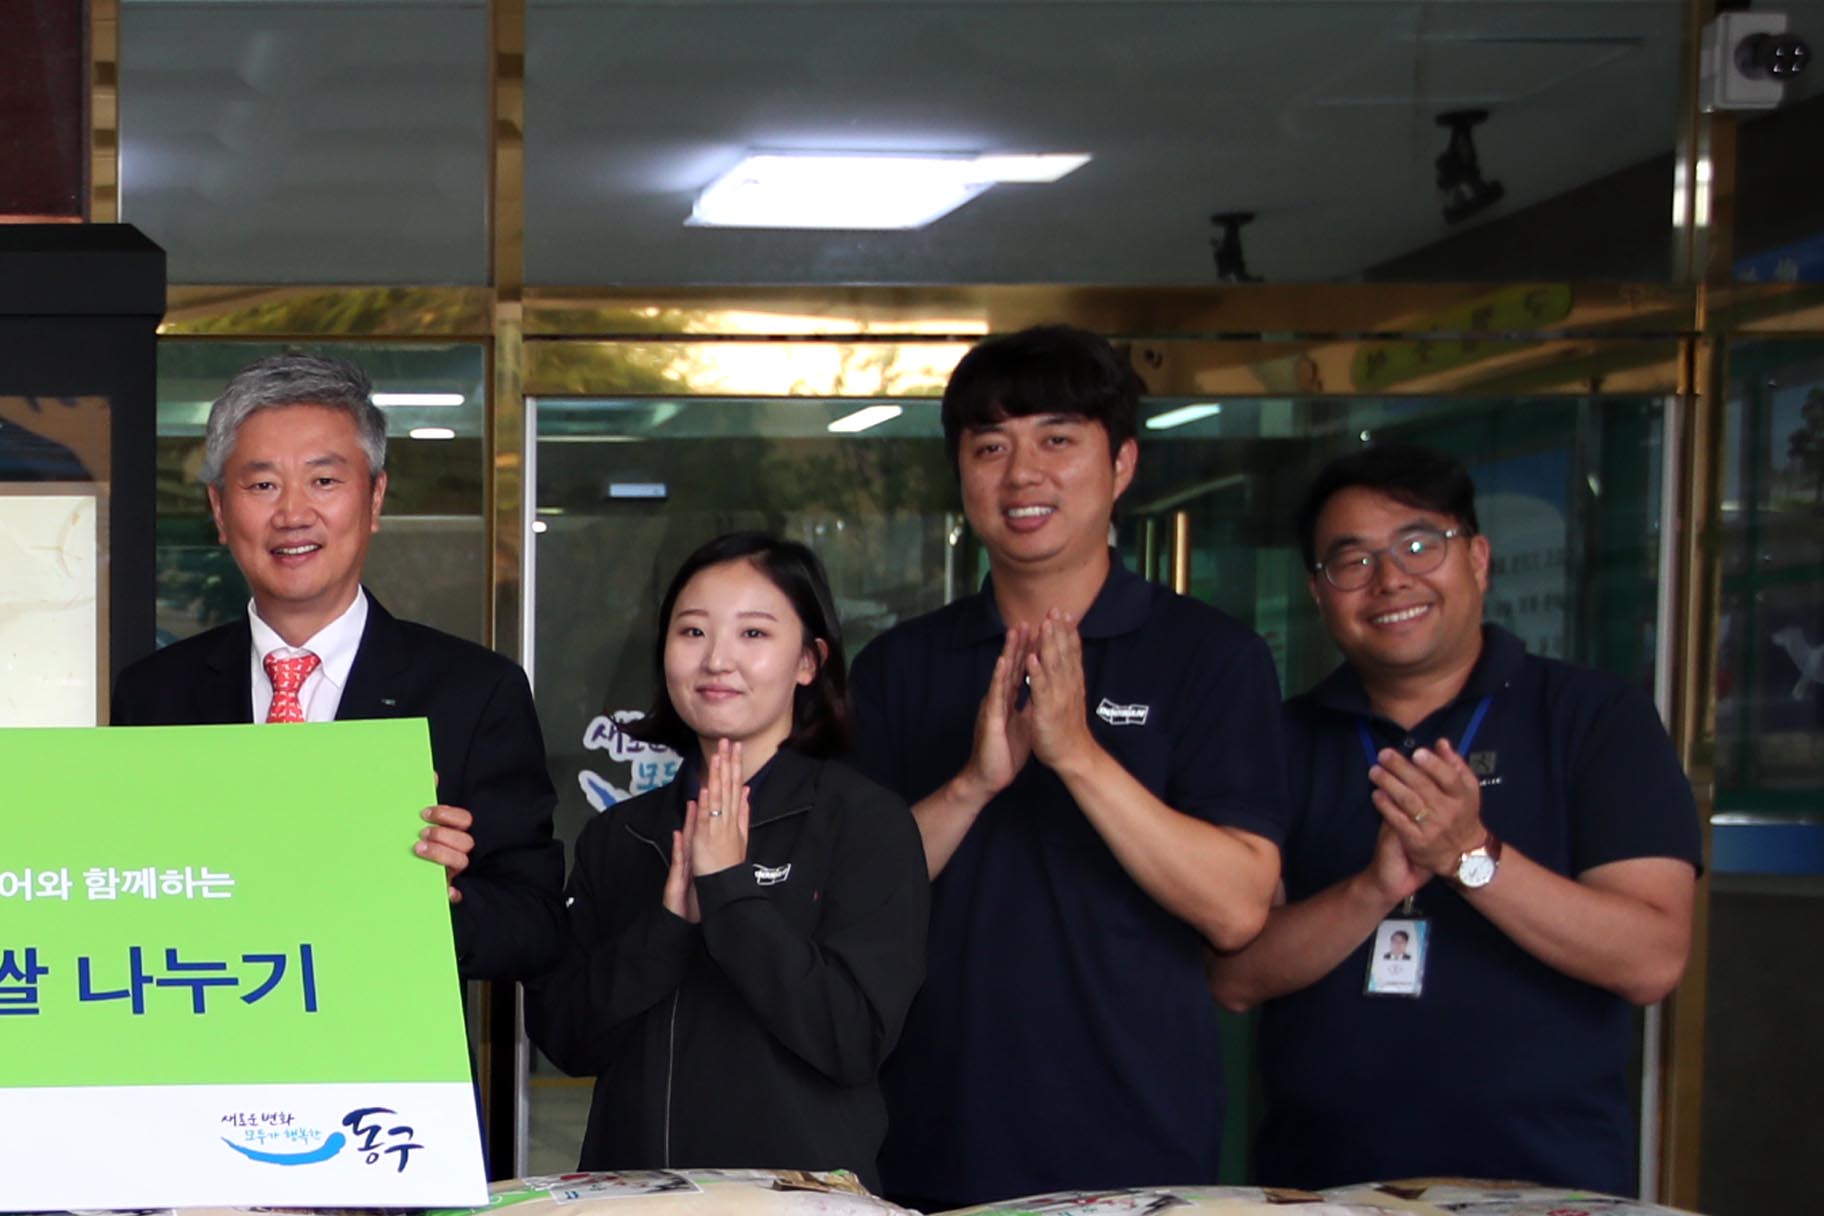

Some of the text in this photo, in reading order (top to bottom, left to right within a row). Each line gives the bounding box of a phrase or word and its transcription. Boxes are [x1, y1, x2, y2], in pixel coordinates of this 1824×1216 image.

[82, 866, 236, 902] 함께하는
[77, 943, 320, 1016] 나누기
[221, 1111, 295, 1127] 새로운 변화
[244, 1127, 321, 1145] 모두가 행복한
[341, 1106, 424, 1173] 동구
